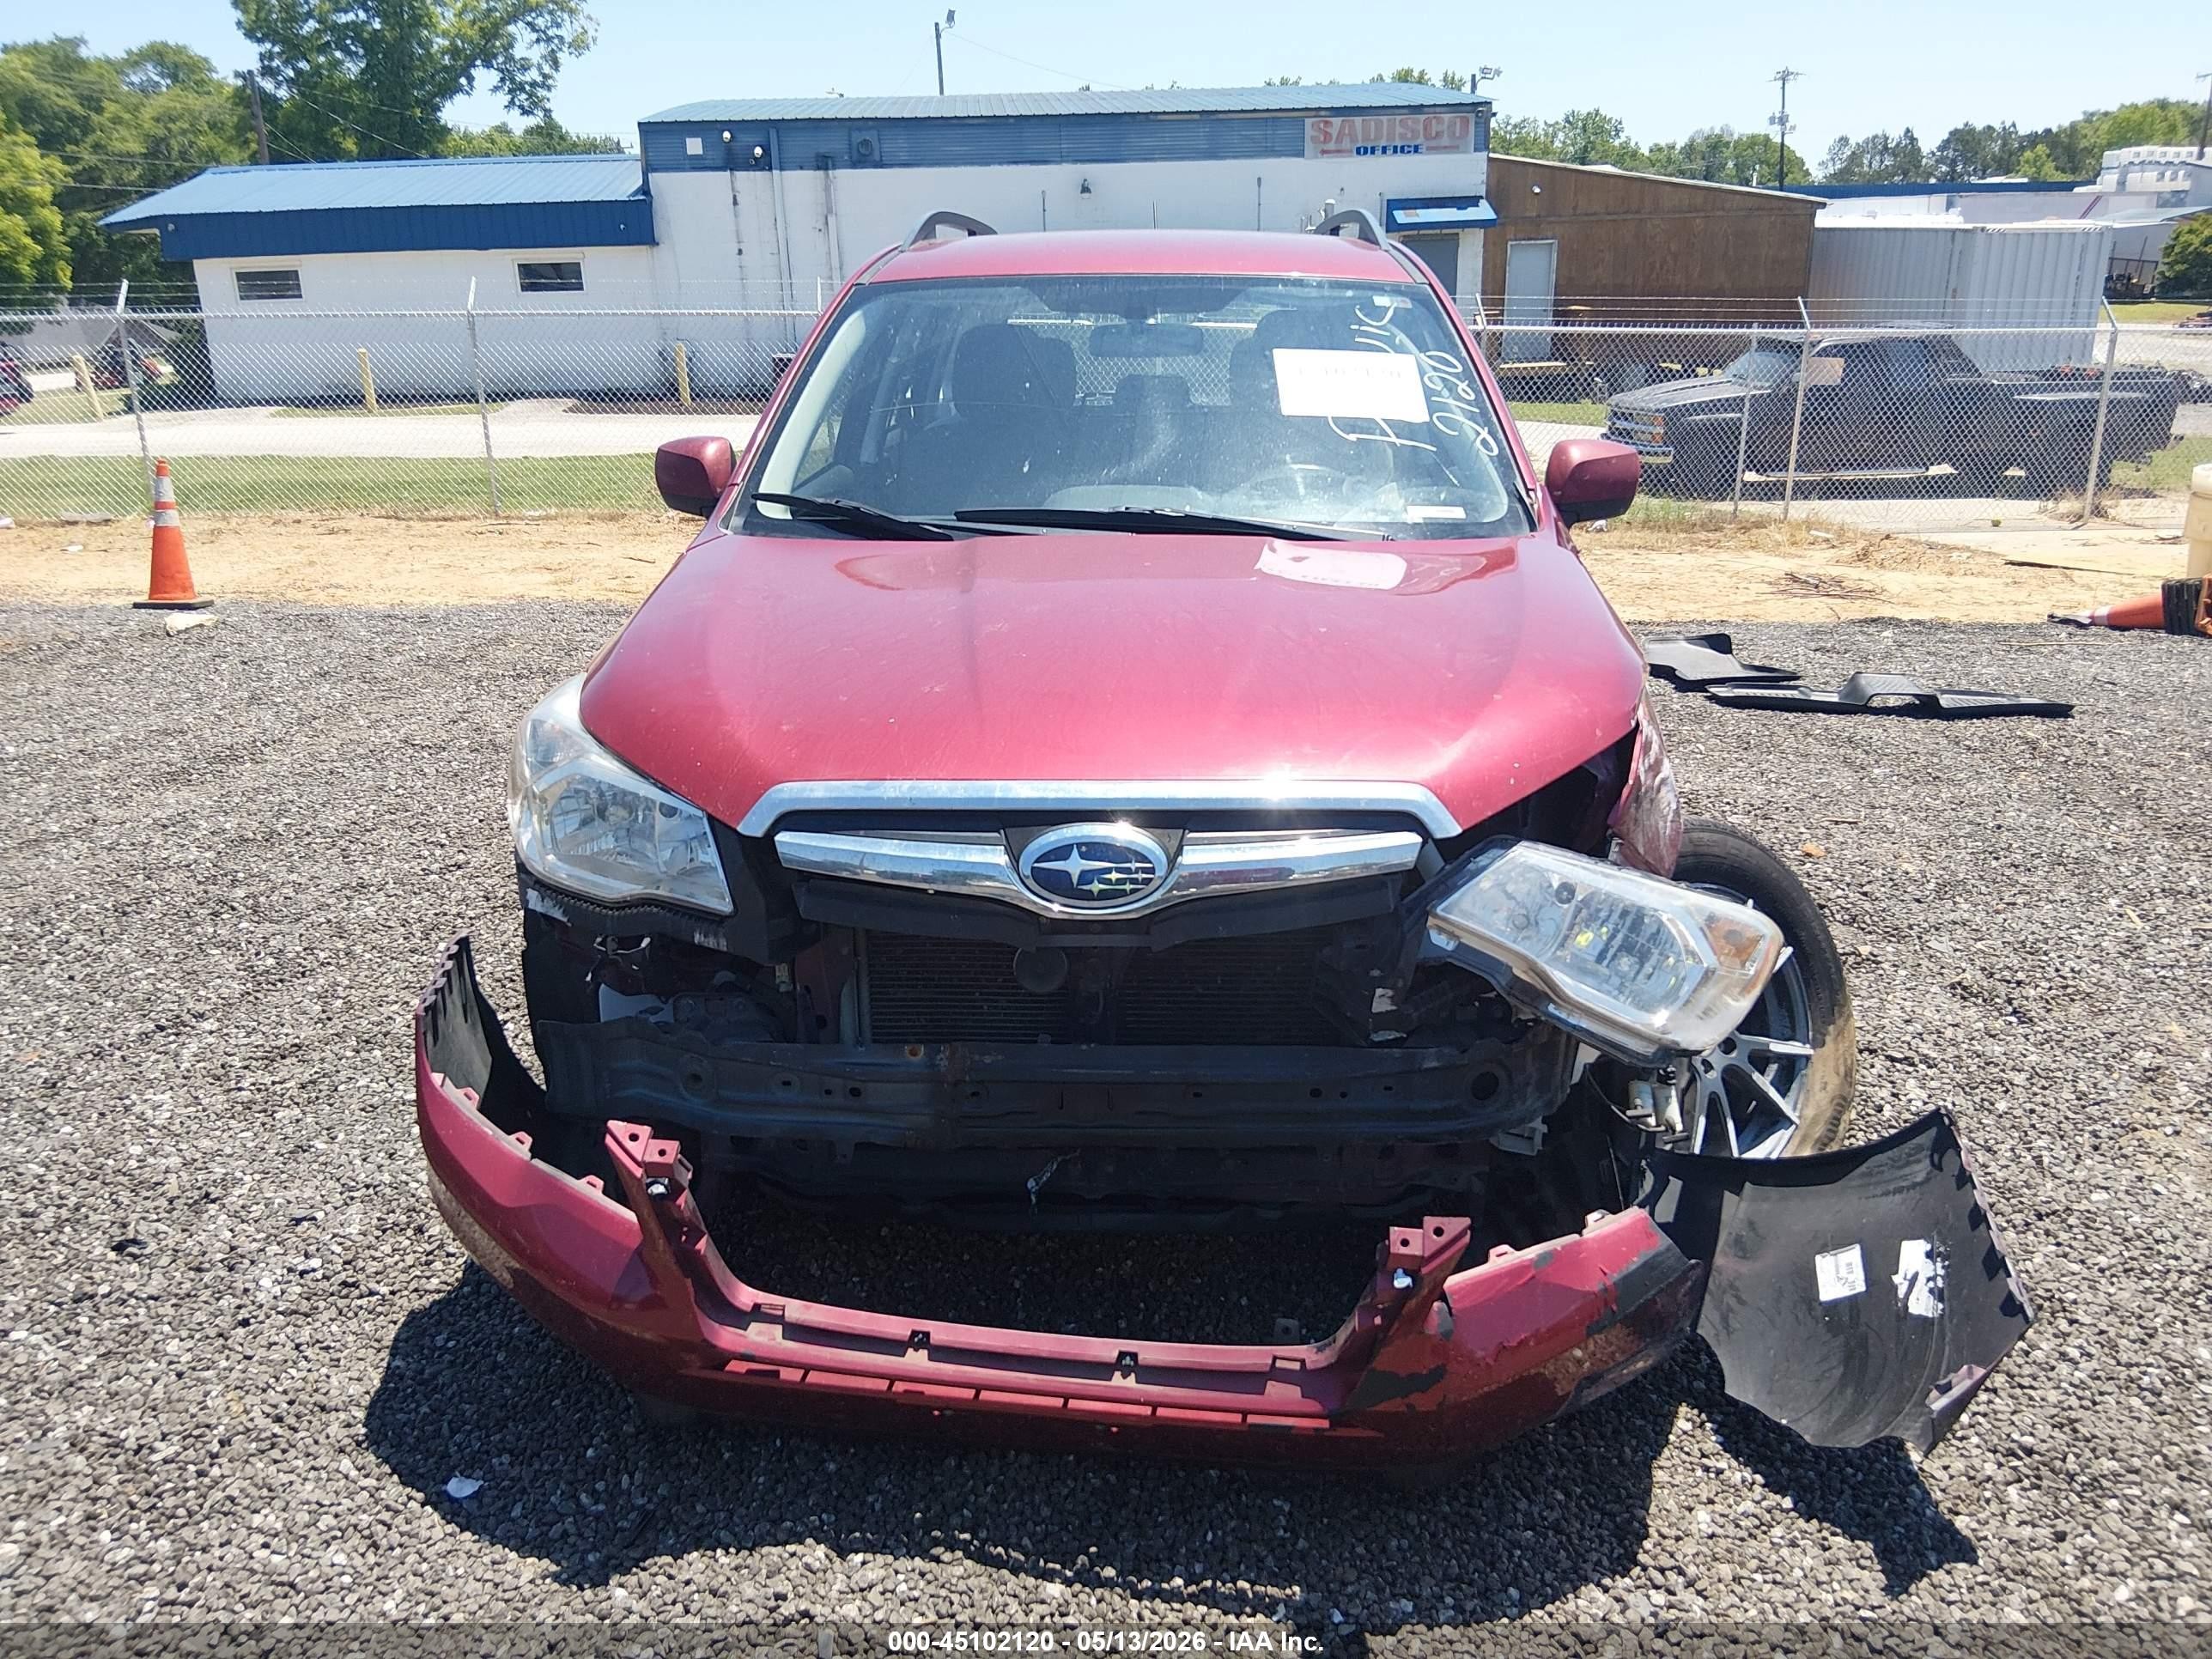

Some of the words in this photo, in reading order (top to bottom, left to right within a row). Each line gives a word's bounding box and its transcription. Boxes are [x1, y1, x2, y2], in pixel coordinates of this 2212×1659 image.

[1310, 116, 1470, 144] SADISCO
[1355, 143, 1424, 156] OFFICE
[1422, 350, 1499, 457] 2120
